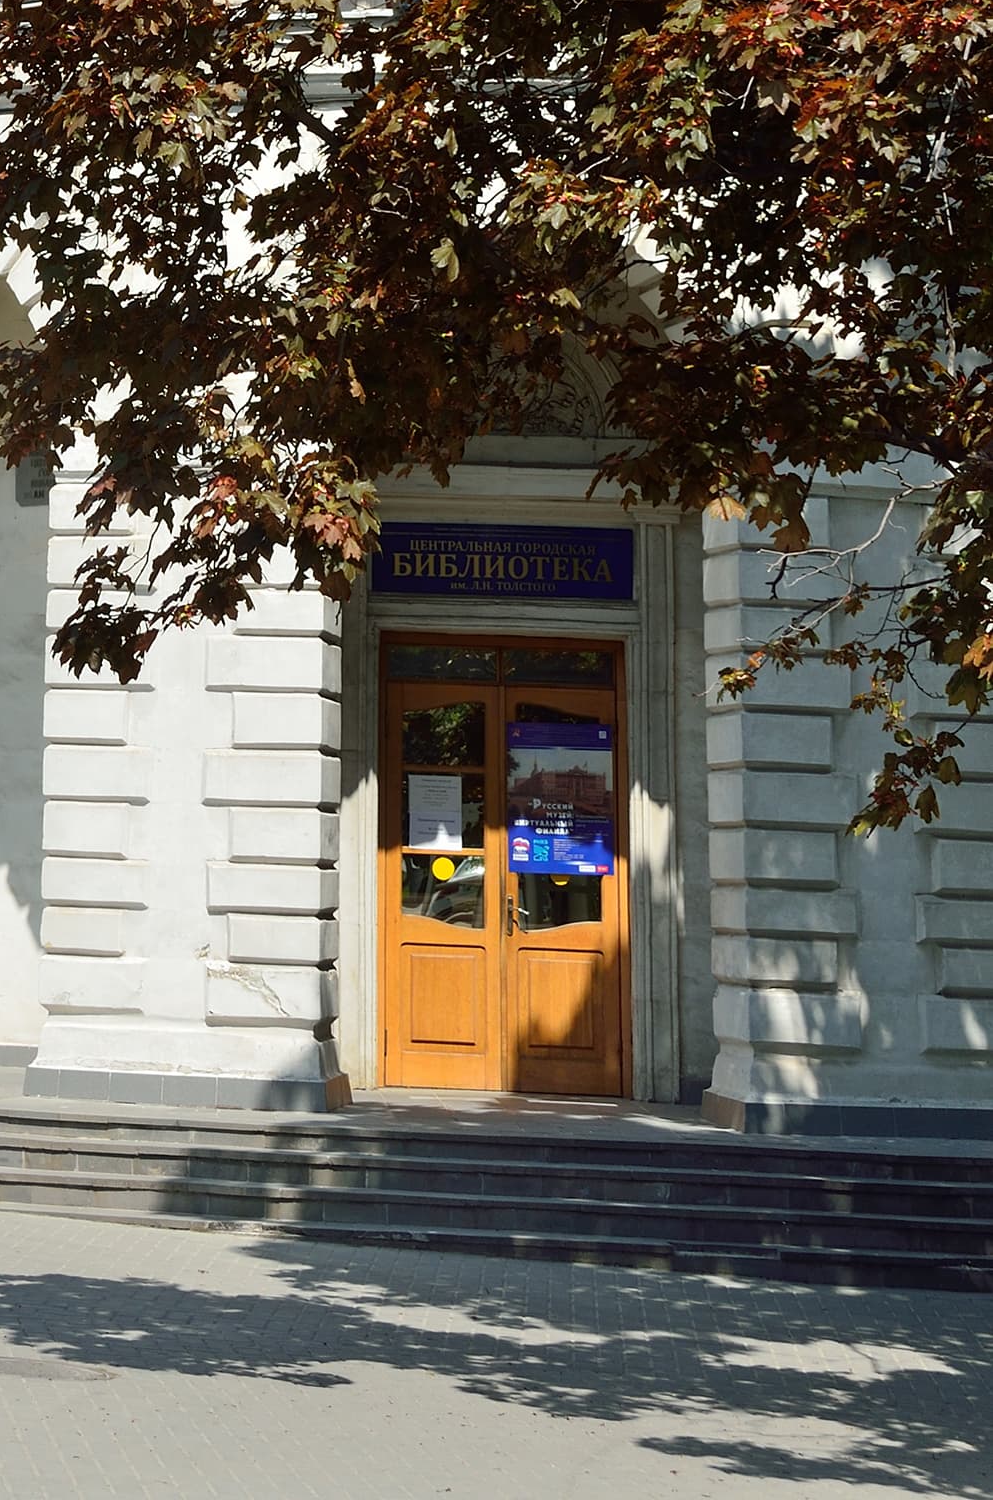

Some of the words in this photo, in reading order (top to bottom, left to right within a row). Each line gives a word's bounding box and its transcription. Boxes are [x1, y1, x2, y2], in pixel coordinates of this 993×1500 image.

[410, 539, 510, 553] ЦЕНТРАЛЬНАЯ
[515, 542, 597, 556] ГОРОДСКАЯ
[392, 552, 614, 582] БИБЛИОТЕКА
[471, 581, 493, 591] Л.Н.
[497, 582, 557, 592] ТОЛСТОГО
